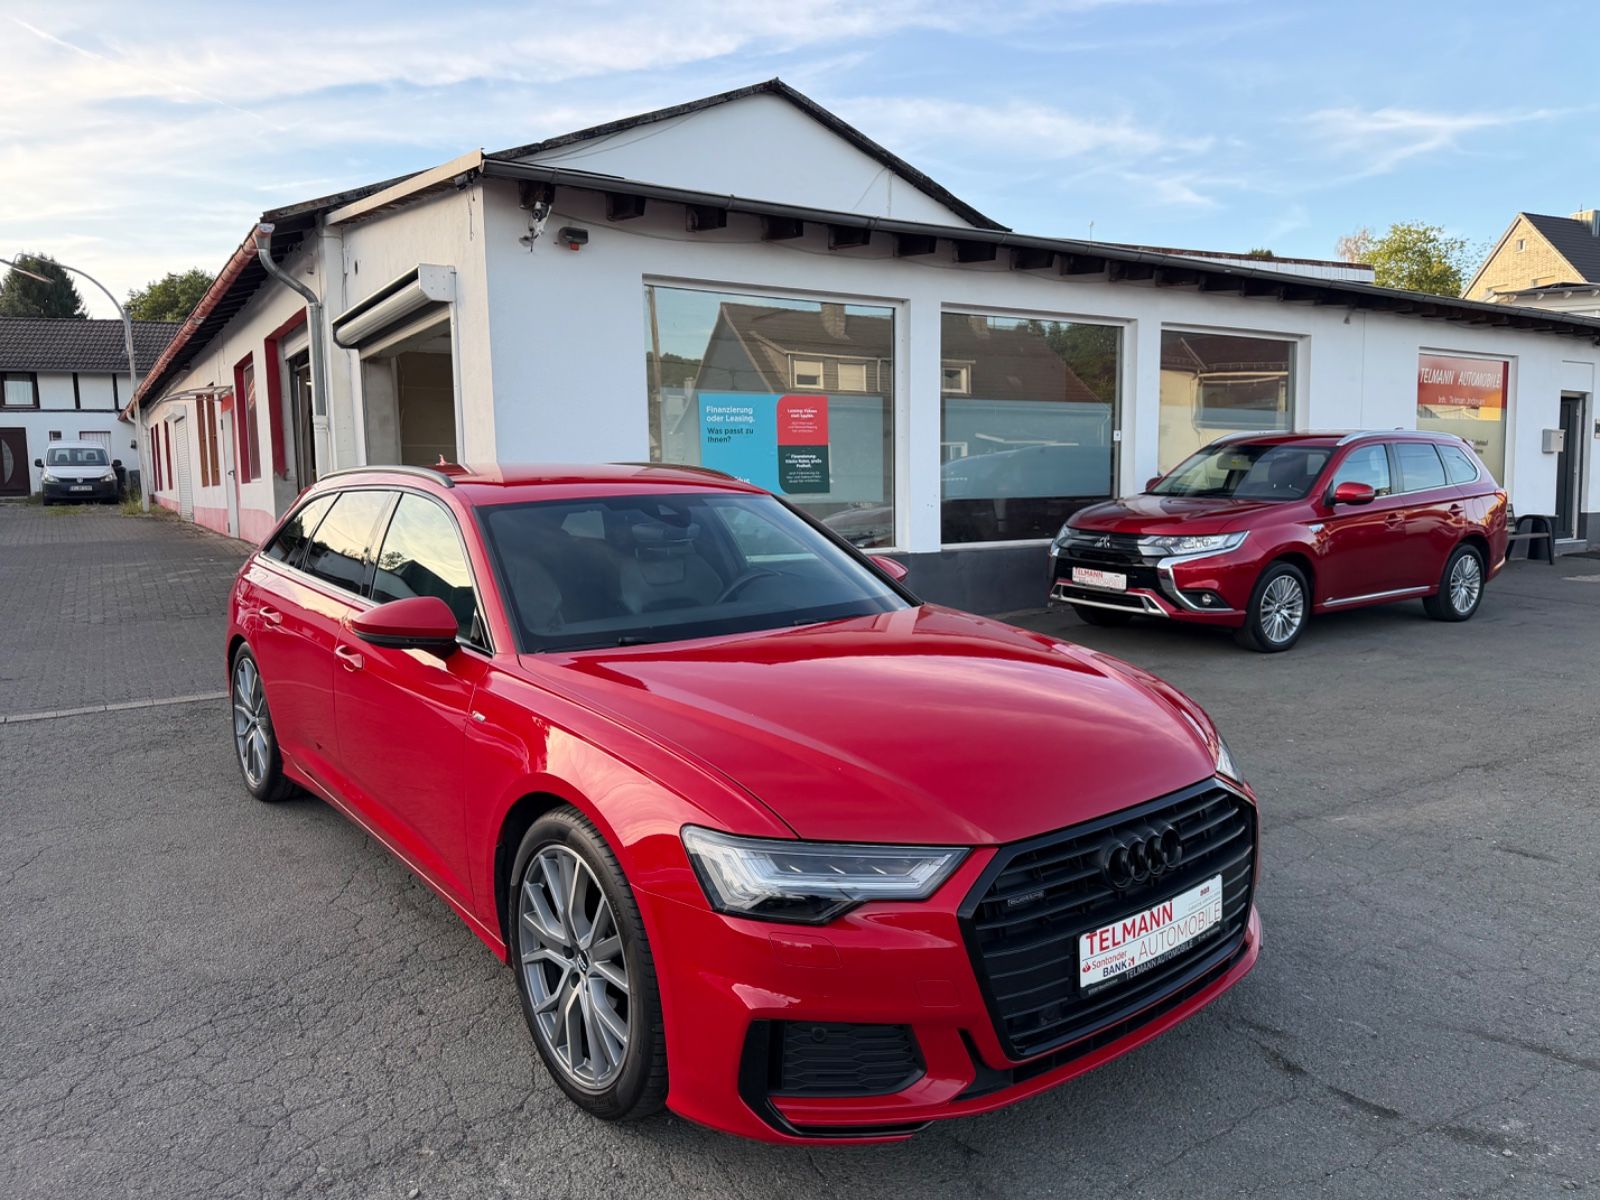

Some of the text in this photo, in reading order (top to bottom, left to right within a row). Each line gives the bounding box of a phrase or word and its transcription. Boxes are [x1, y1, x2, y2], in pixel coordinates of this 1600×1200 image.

[1420, 367, 1501, 388] TELMANN AUTOMOBILE
[706, 405, 753, 414] Finanzierung
[725, 414, 755, 423] Leasing.
[707, 427, 722, 435] Was
[724, 427, 743, 436] passt
[1085, 901, 1173, 955] TELMANN
[1138, 901, 1221, 961] AUTOMOBILE
[1092, 950, 1128, 970] Santander
[1126, 939, 1193, 980] TELMANN AUTOMOBILE
